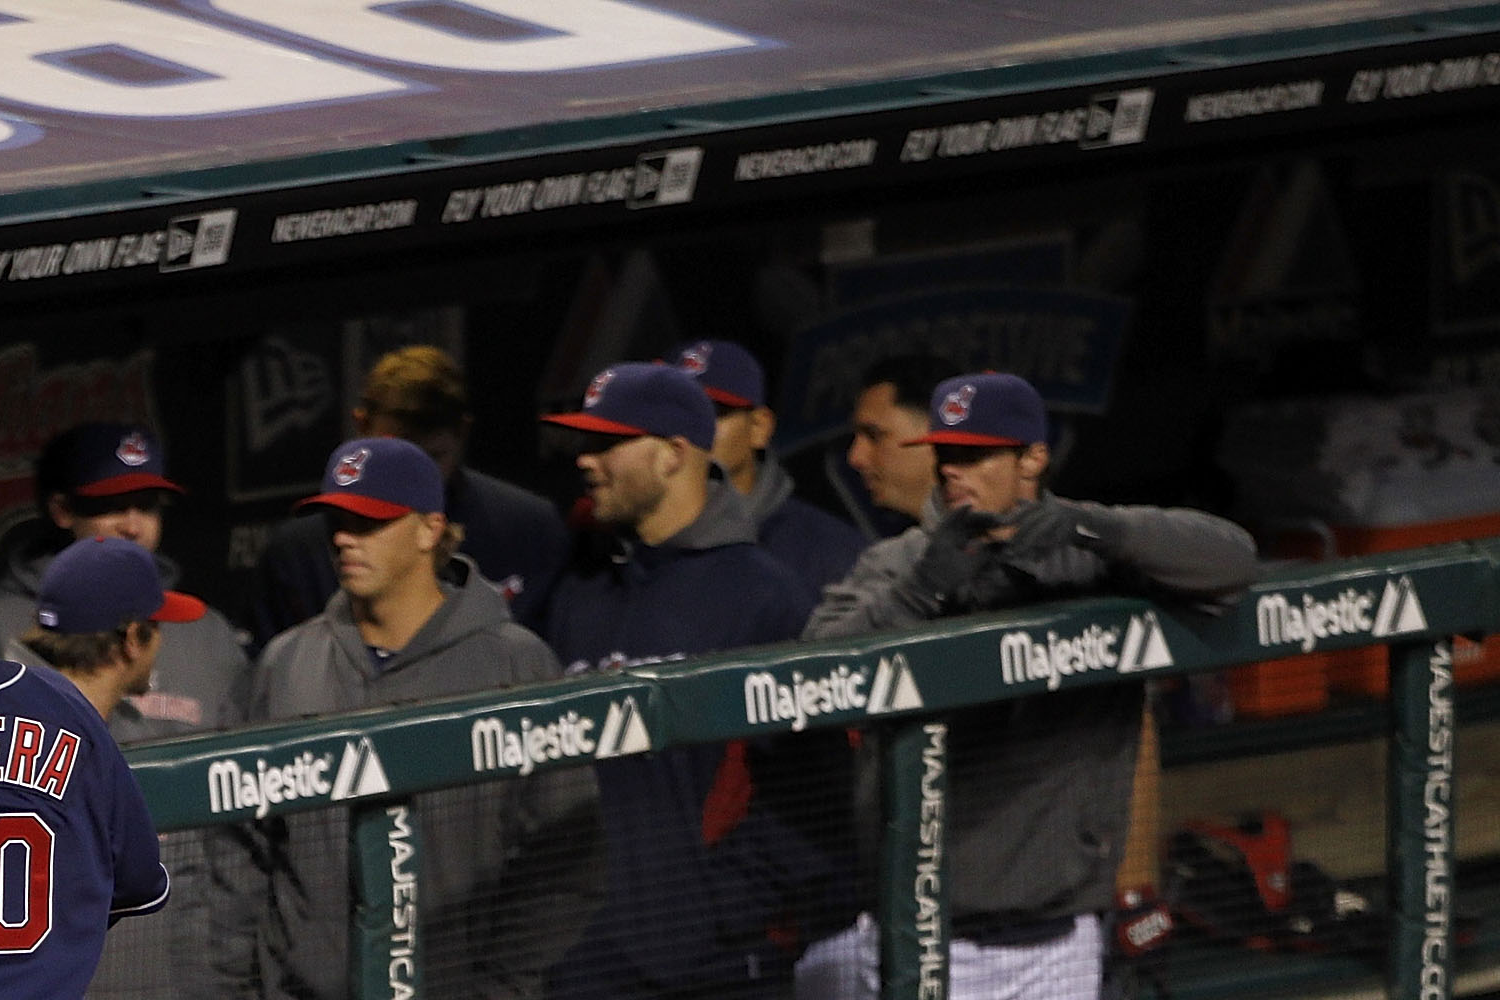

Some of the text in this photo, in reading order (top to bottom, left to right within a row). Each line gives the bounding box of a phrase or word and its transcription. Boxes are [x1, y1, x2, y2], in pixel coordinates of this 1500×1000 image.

[1257, 587, 1374, 653] Majestic
[1000, 623, 1119, 691] Majestic
[744, 664, 868, 732] Majestic
[471, 710, 596, 777] Majestic
[208, 752, 332, 820] Majestic
